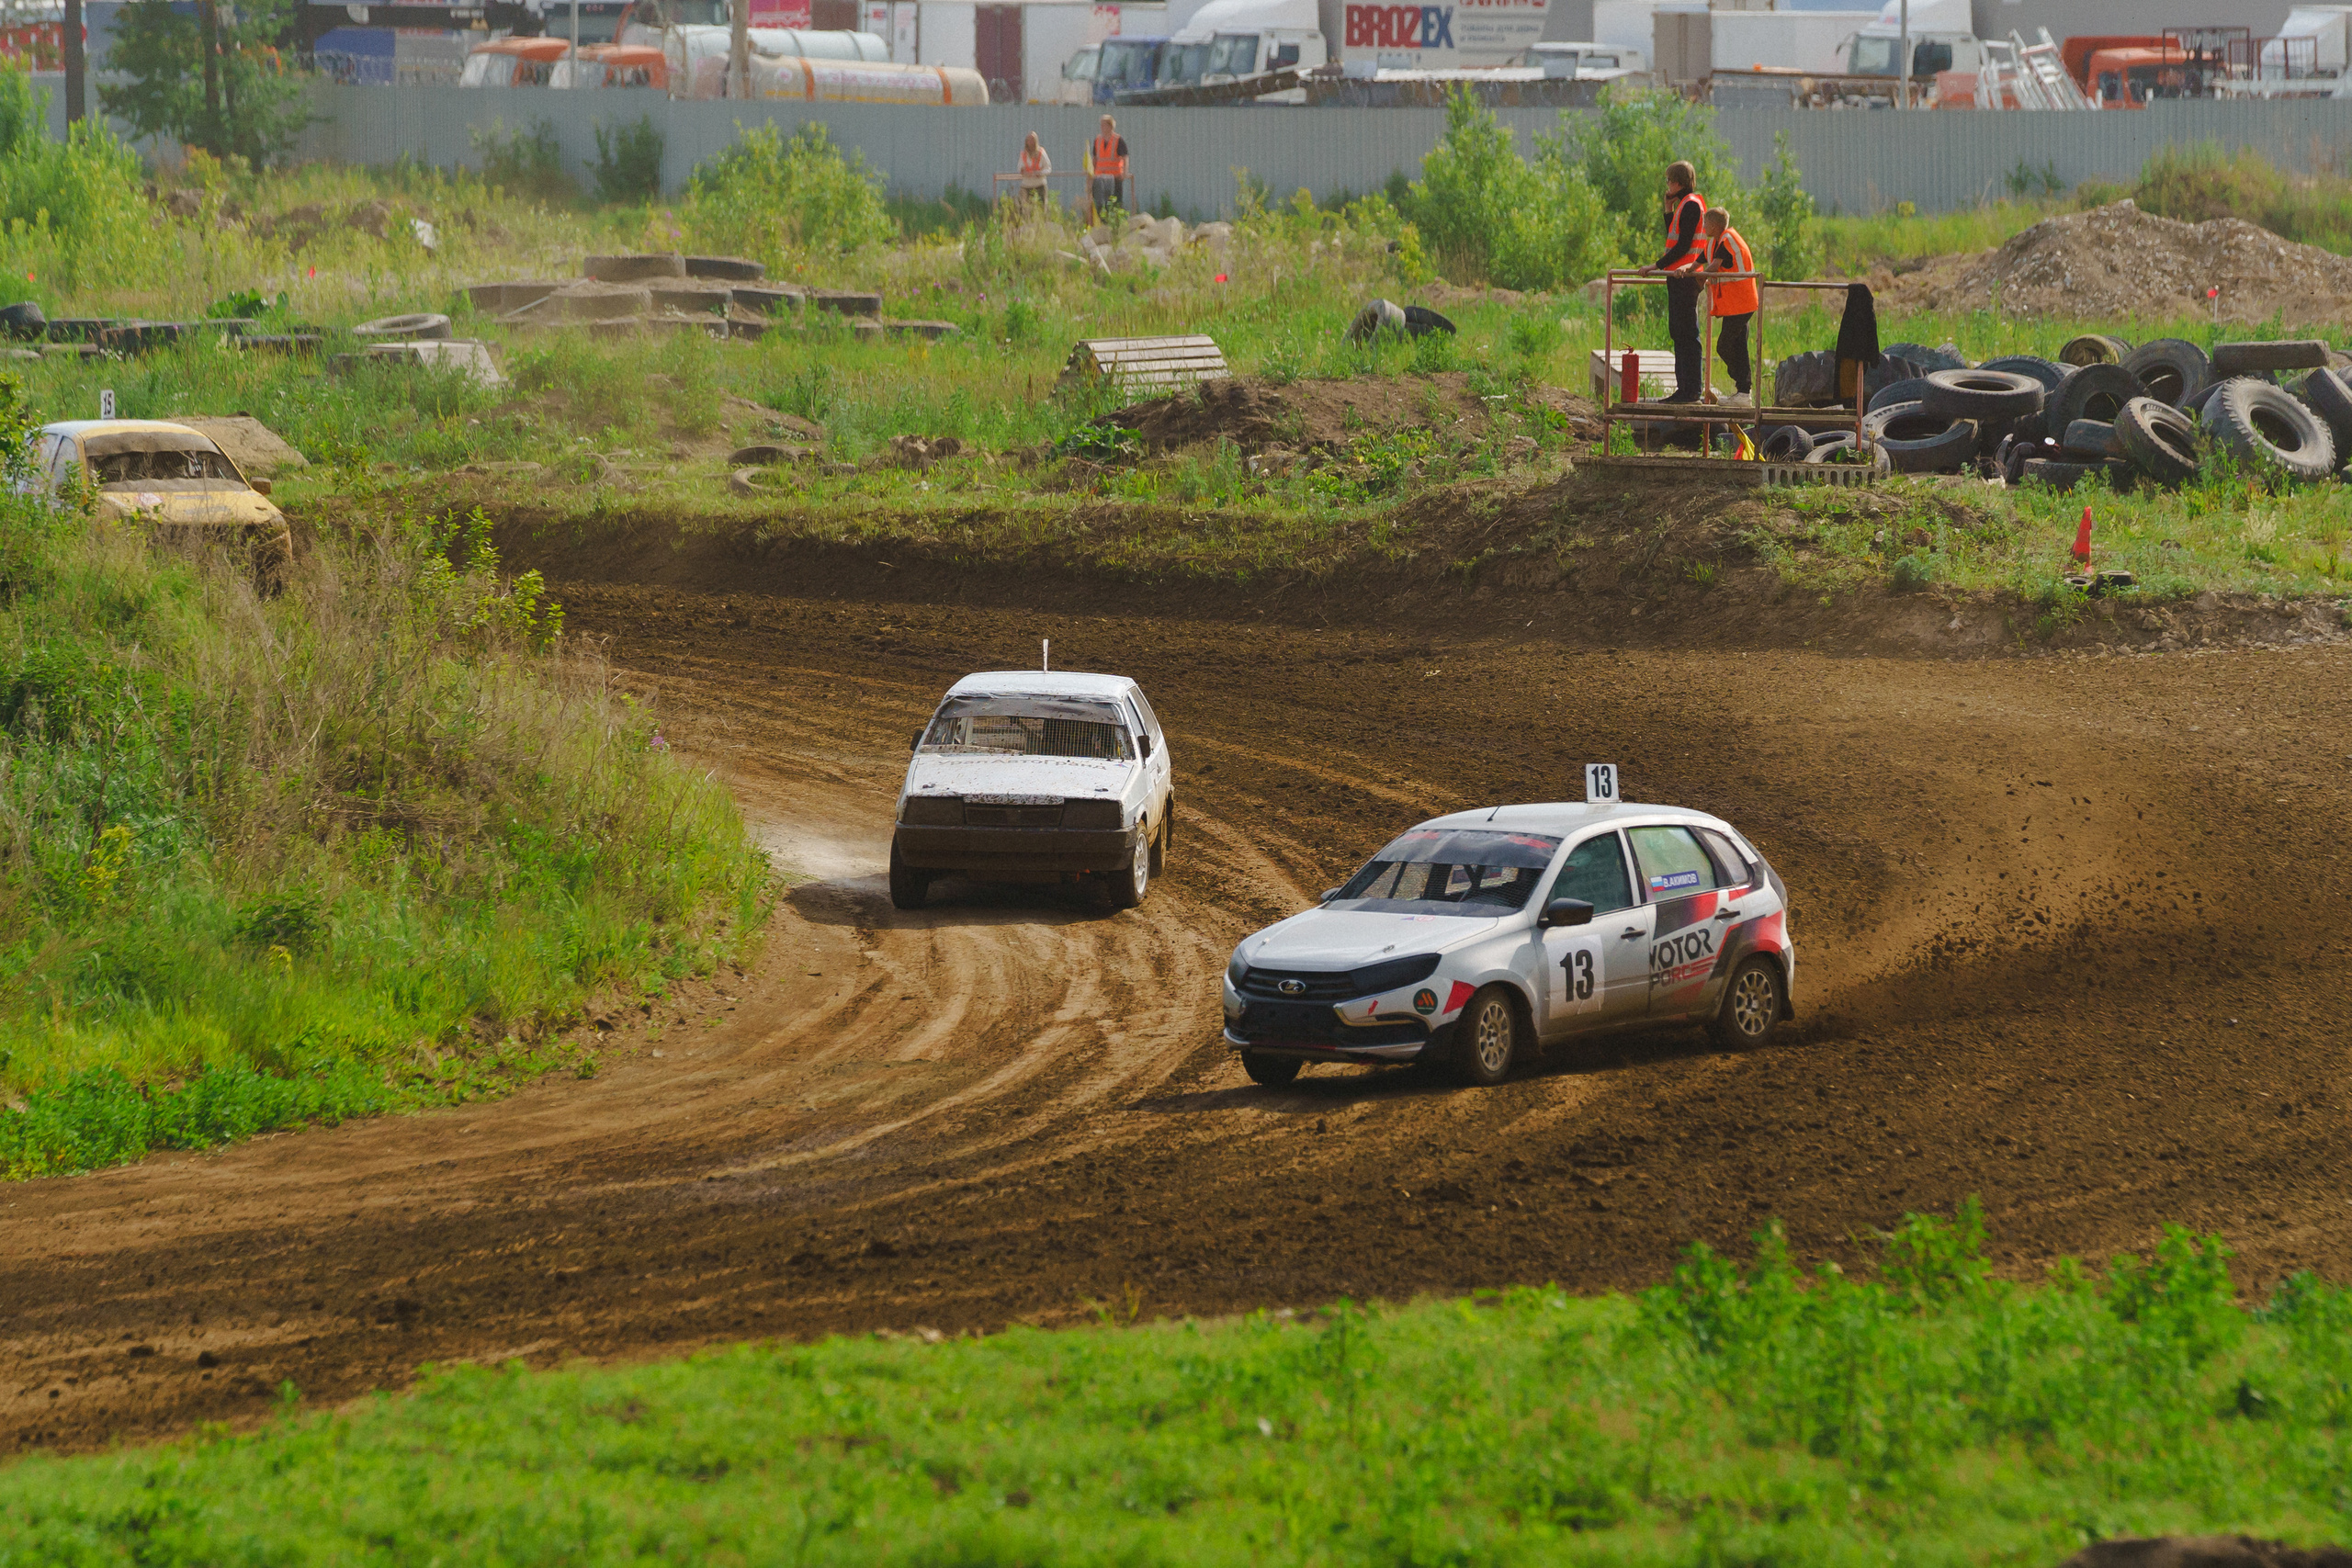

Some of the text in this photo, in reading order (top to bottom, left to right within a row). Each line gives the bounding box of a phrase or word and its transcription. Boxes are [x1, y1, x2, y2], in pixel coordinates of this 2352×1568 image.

[1345, 5, 1453, 48] BROZEX
[103, 393, 112, 415] 15
[1591, 765, 1612, 798] 13
[1663, 873, 1698, 888] В.АКИМОВ
[1559, 949, 1595, 1003] 13
